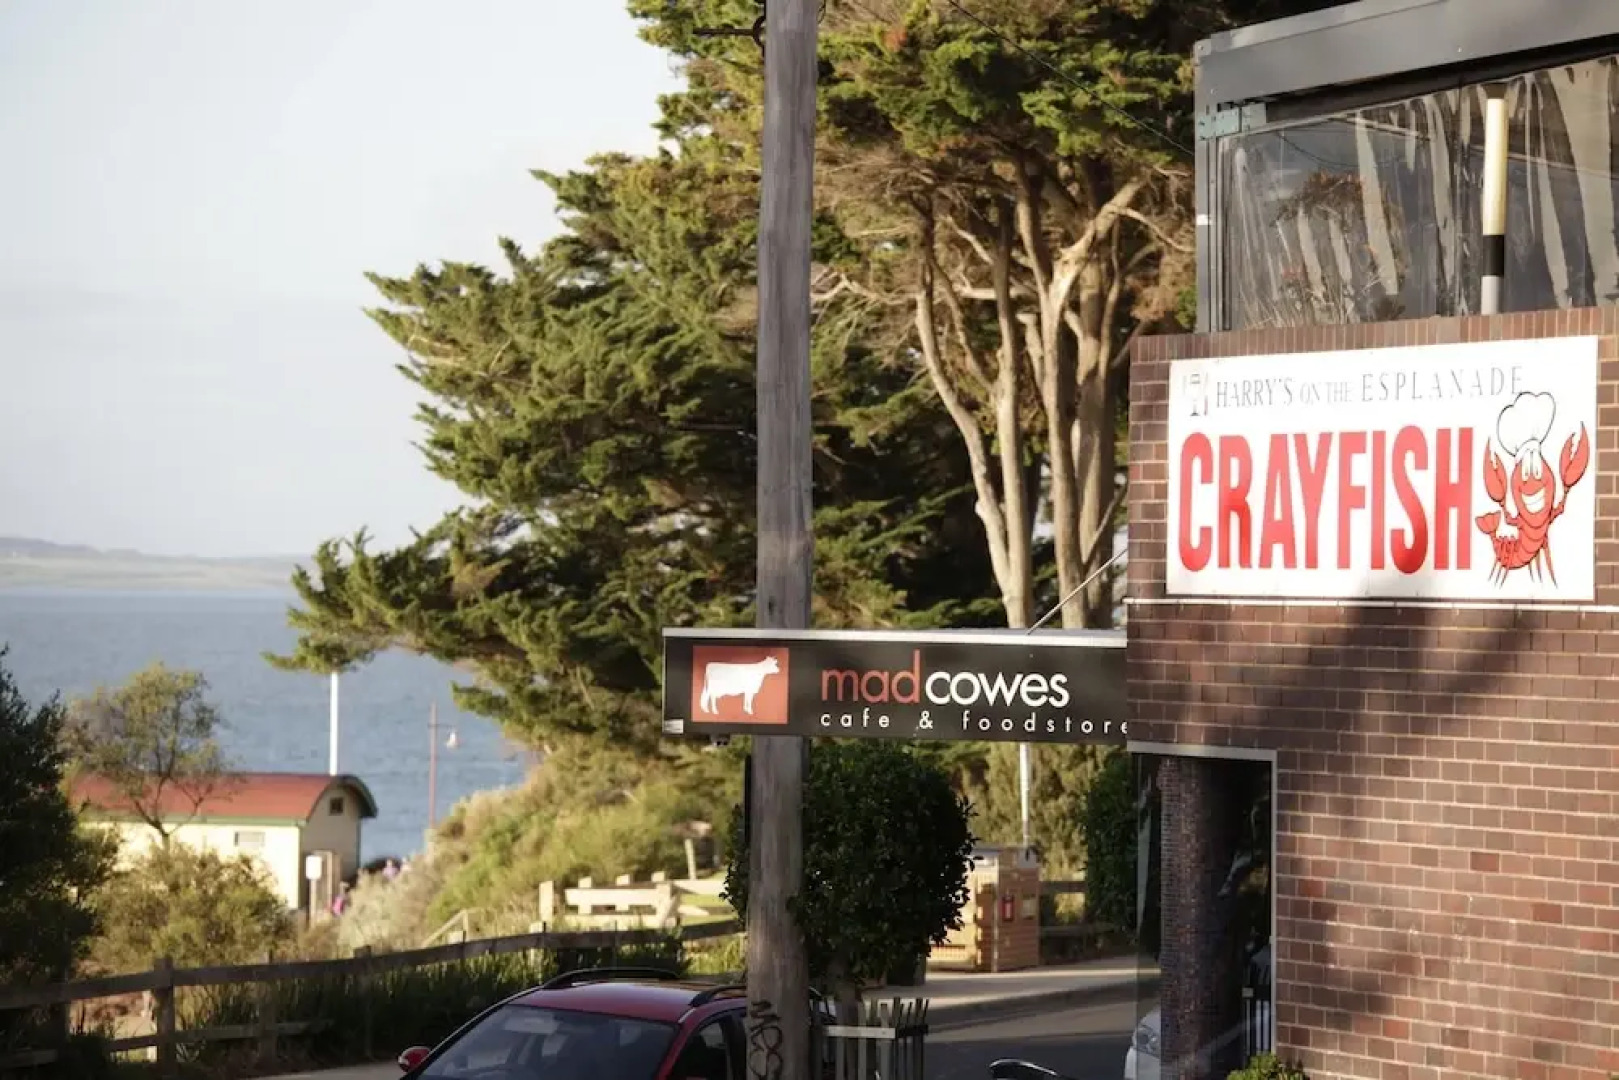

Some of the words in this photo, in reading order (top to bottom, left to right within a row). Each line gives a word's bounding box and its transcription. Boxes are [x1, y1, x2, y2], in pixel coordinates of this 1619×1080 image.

[1216, 377, 1294, 409] HARRY'S
[1300, 381, 1321, 405] ON
[1326, 381, 1352, 403] THE
[1362, 366, 1522, 402] ESPLANADE
[1178, 425, 1474, 574] CRAYFISH
[820, 707, 890, 728] cafe
[919, 710, 934, 729] &
